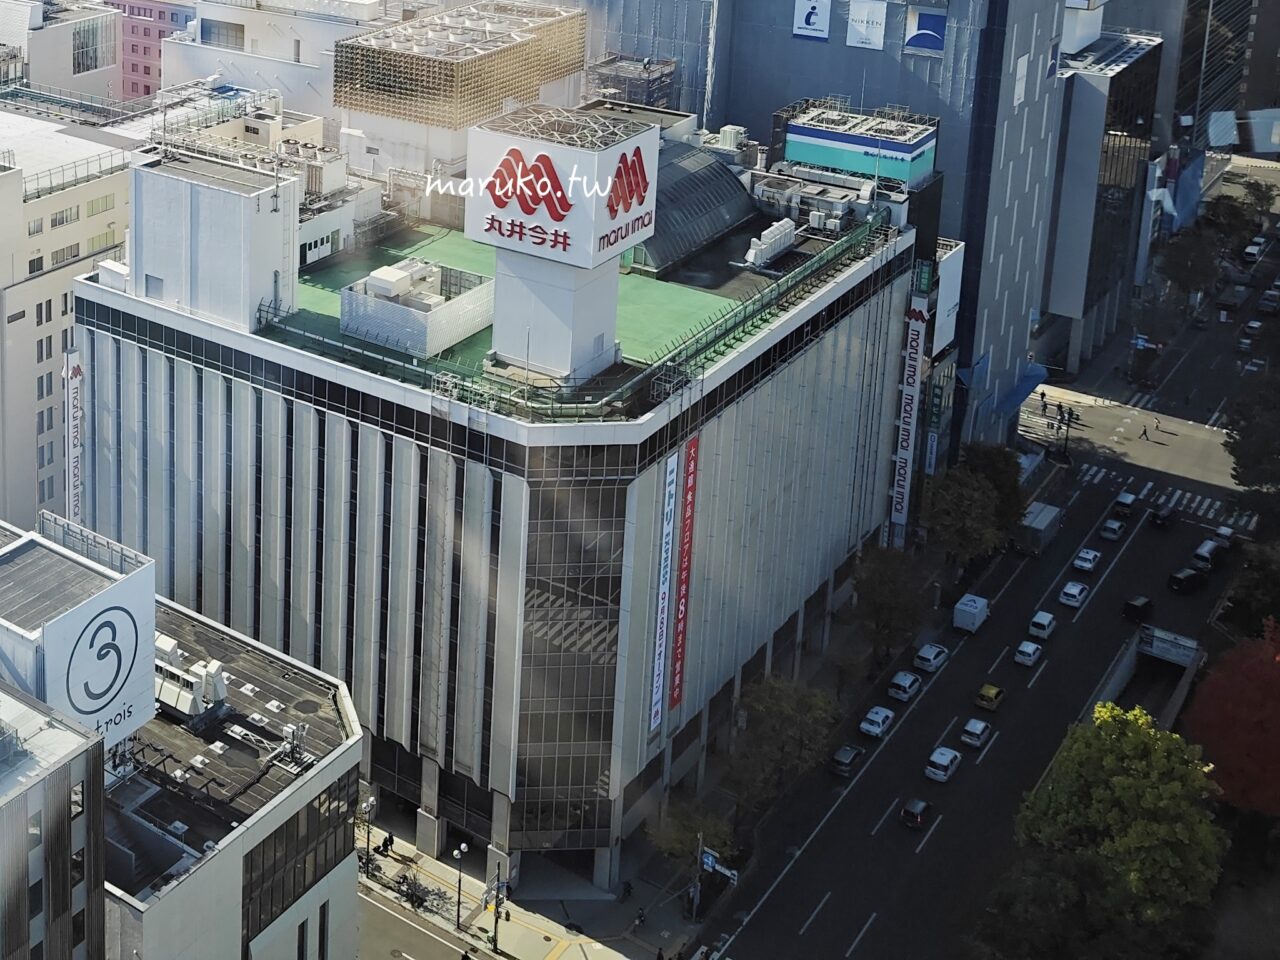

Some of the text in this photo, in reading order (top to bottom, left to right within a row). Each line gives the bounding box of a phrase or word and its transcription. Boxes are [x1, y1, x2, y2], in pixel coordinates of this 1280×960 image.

[851, 17, 882, 27] NIKKEN
[483, 214, 571, 252] 丸井今井
[665, 467, 675, 526] ニトリ
[661, 531, 671, 586] EXPRESS
